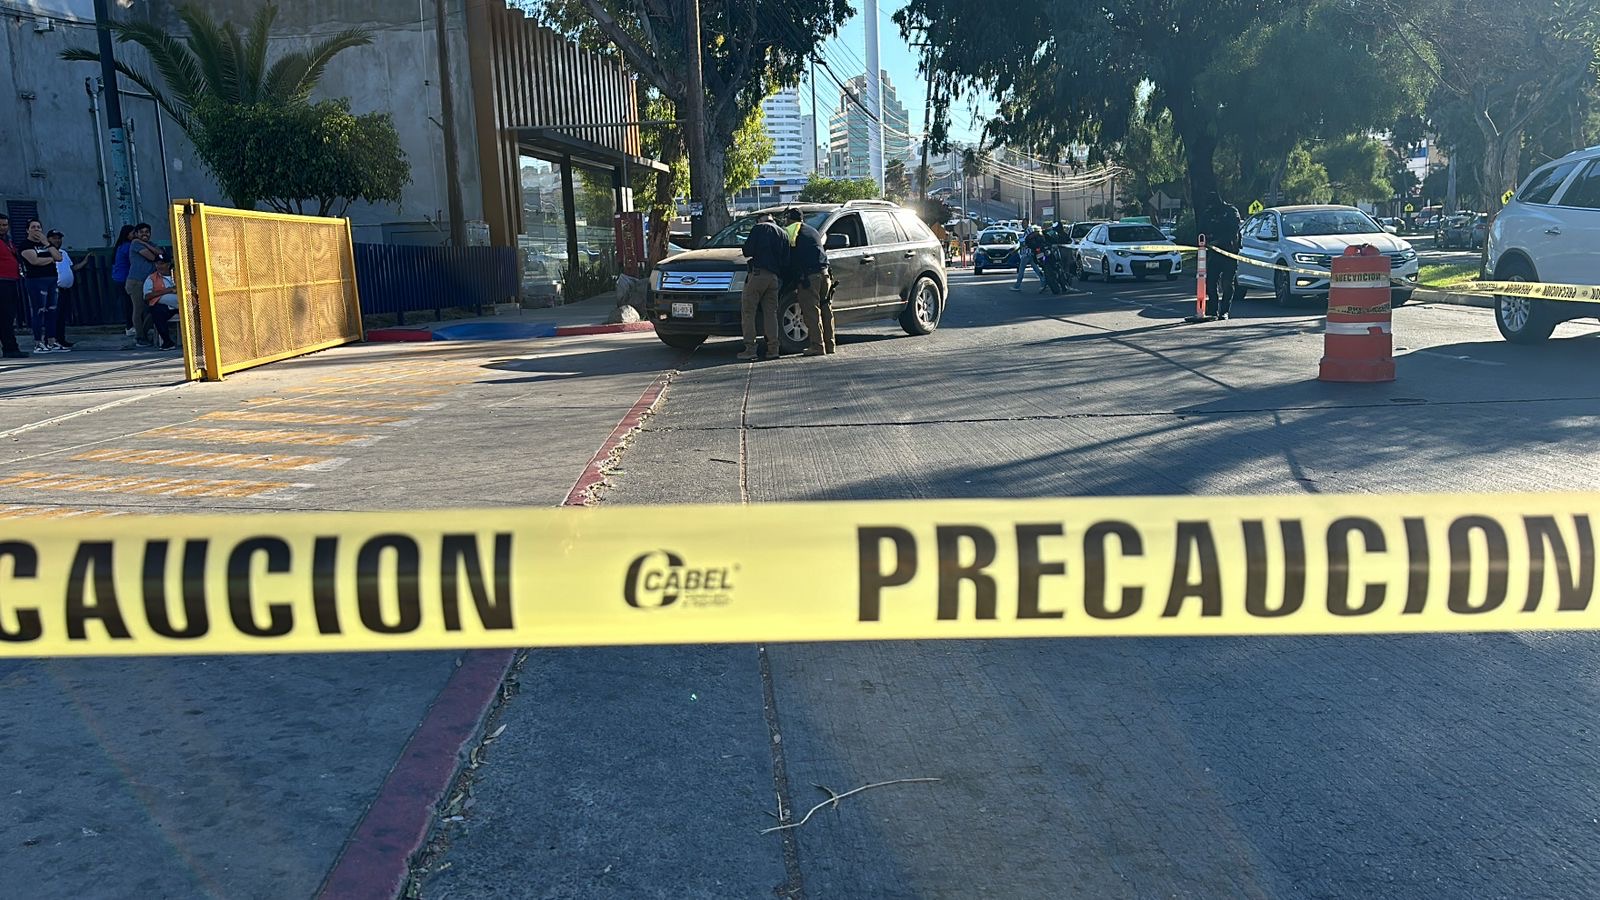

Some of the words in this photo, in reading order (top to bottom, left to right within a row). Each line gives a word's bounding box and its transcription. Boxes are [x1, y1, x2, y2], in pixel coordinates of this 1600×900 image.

[0, 531, 515, 644] CAUCION
[856, 514, 1596, 622] PRECAUCION
[644, 568, 734, 592] CABEL
